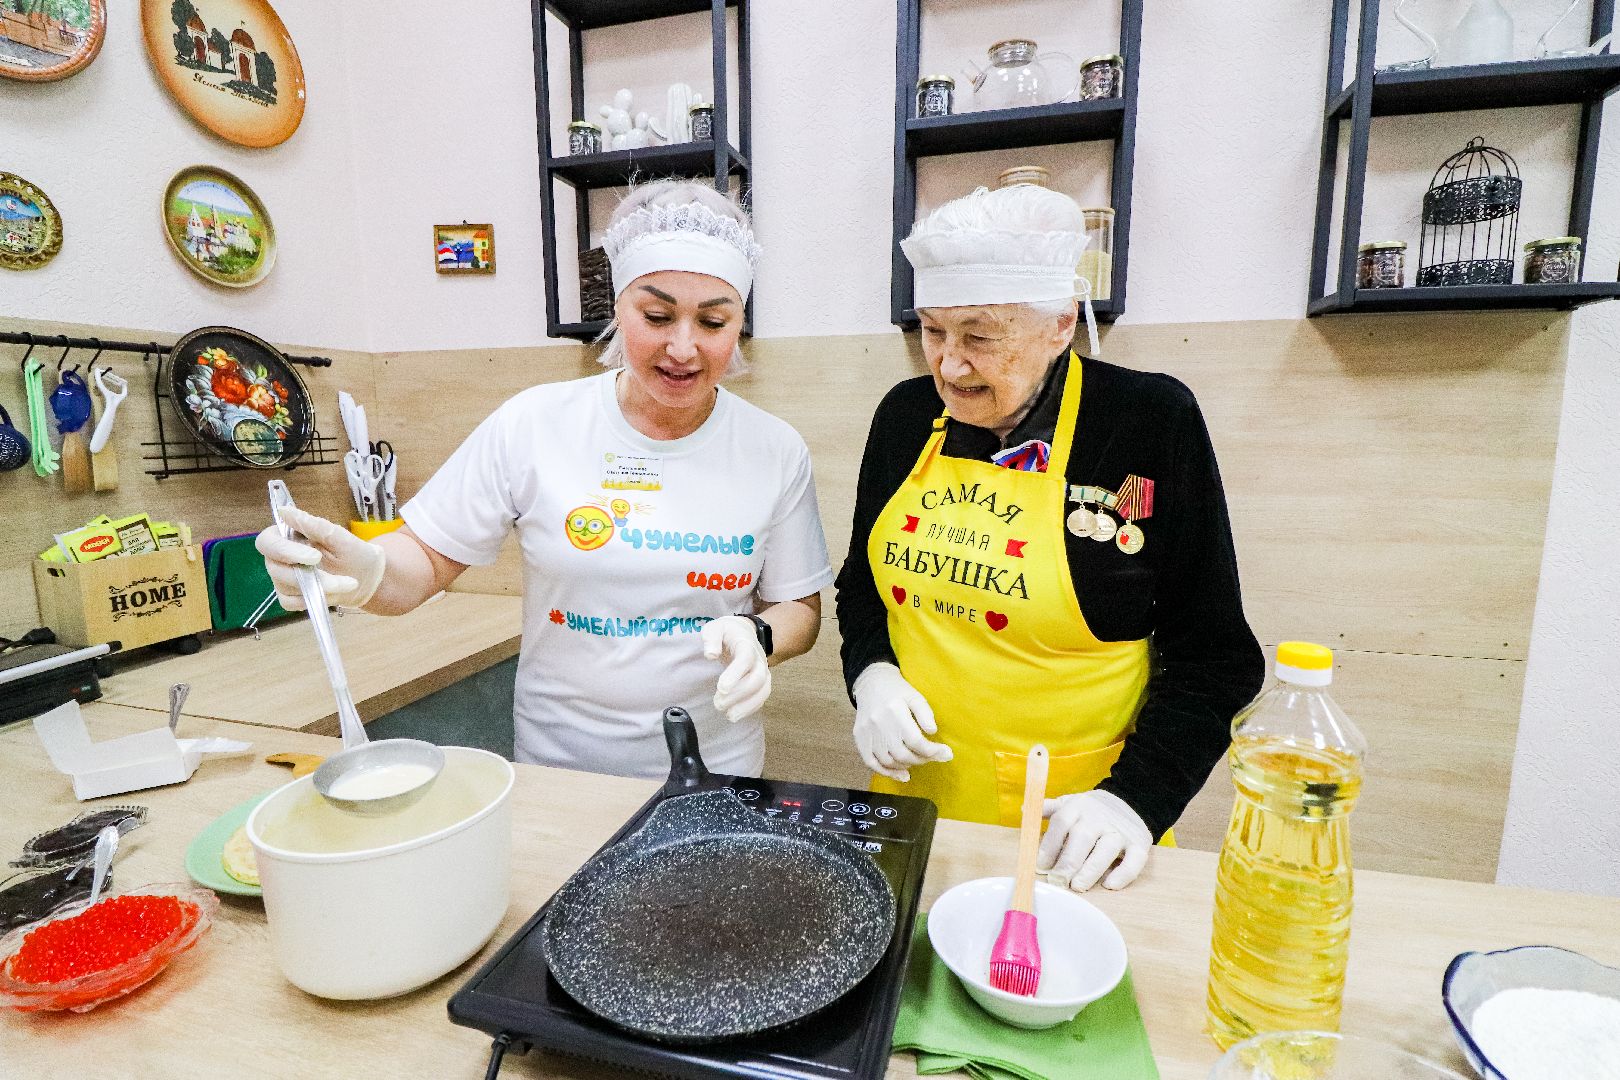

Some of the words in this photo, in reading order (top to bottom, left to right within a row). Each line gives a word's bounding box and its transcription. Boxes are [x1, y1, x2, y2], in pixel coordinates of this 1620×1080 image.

[921, 483, 1024, 525] САМАЯ
[926, 523, 991, 551] ЛУЧШАЯ
[883, 541, 1031, 600] БАБУШКА
[109, 582, 187, 613] HOME
[913, 594, 921, 608] В
[934, 599, 977, 623] МИРЕ
